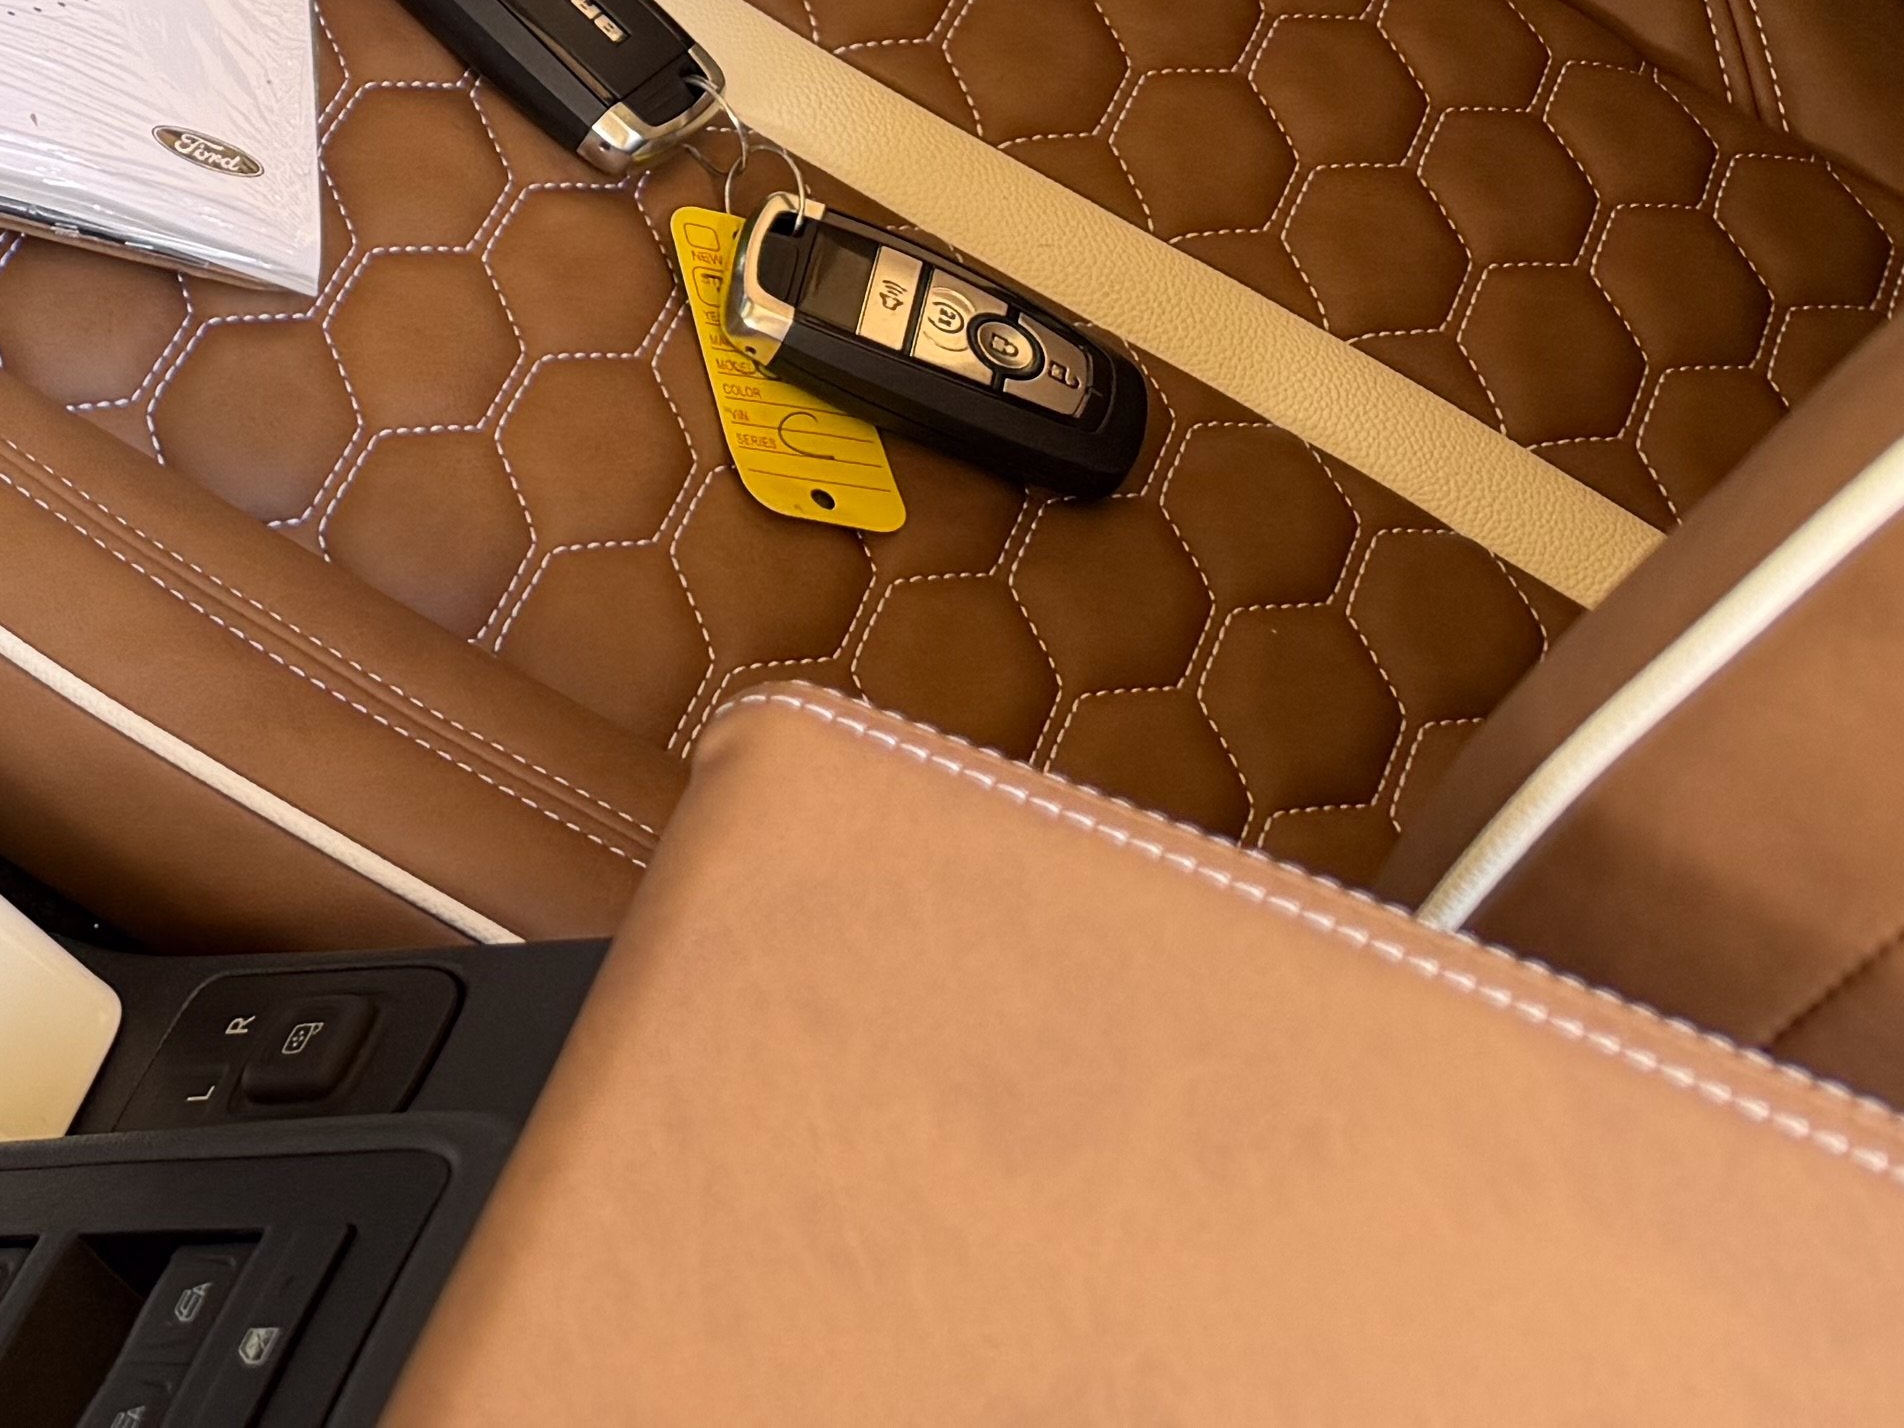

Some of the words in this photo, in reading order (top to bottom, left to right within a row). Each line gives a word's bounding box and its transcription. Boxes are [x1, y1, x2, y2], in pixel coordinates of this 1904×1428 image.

[175, 133, 241, 171] Ford
[692, 250, 723, 265] NEW
[723, 383, 761, 399] COLOR
[736, 432, 776, 449] SERIES
[225, 1014, 256, 1034] R
[187, 1084, 215, 1102] L
